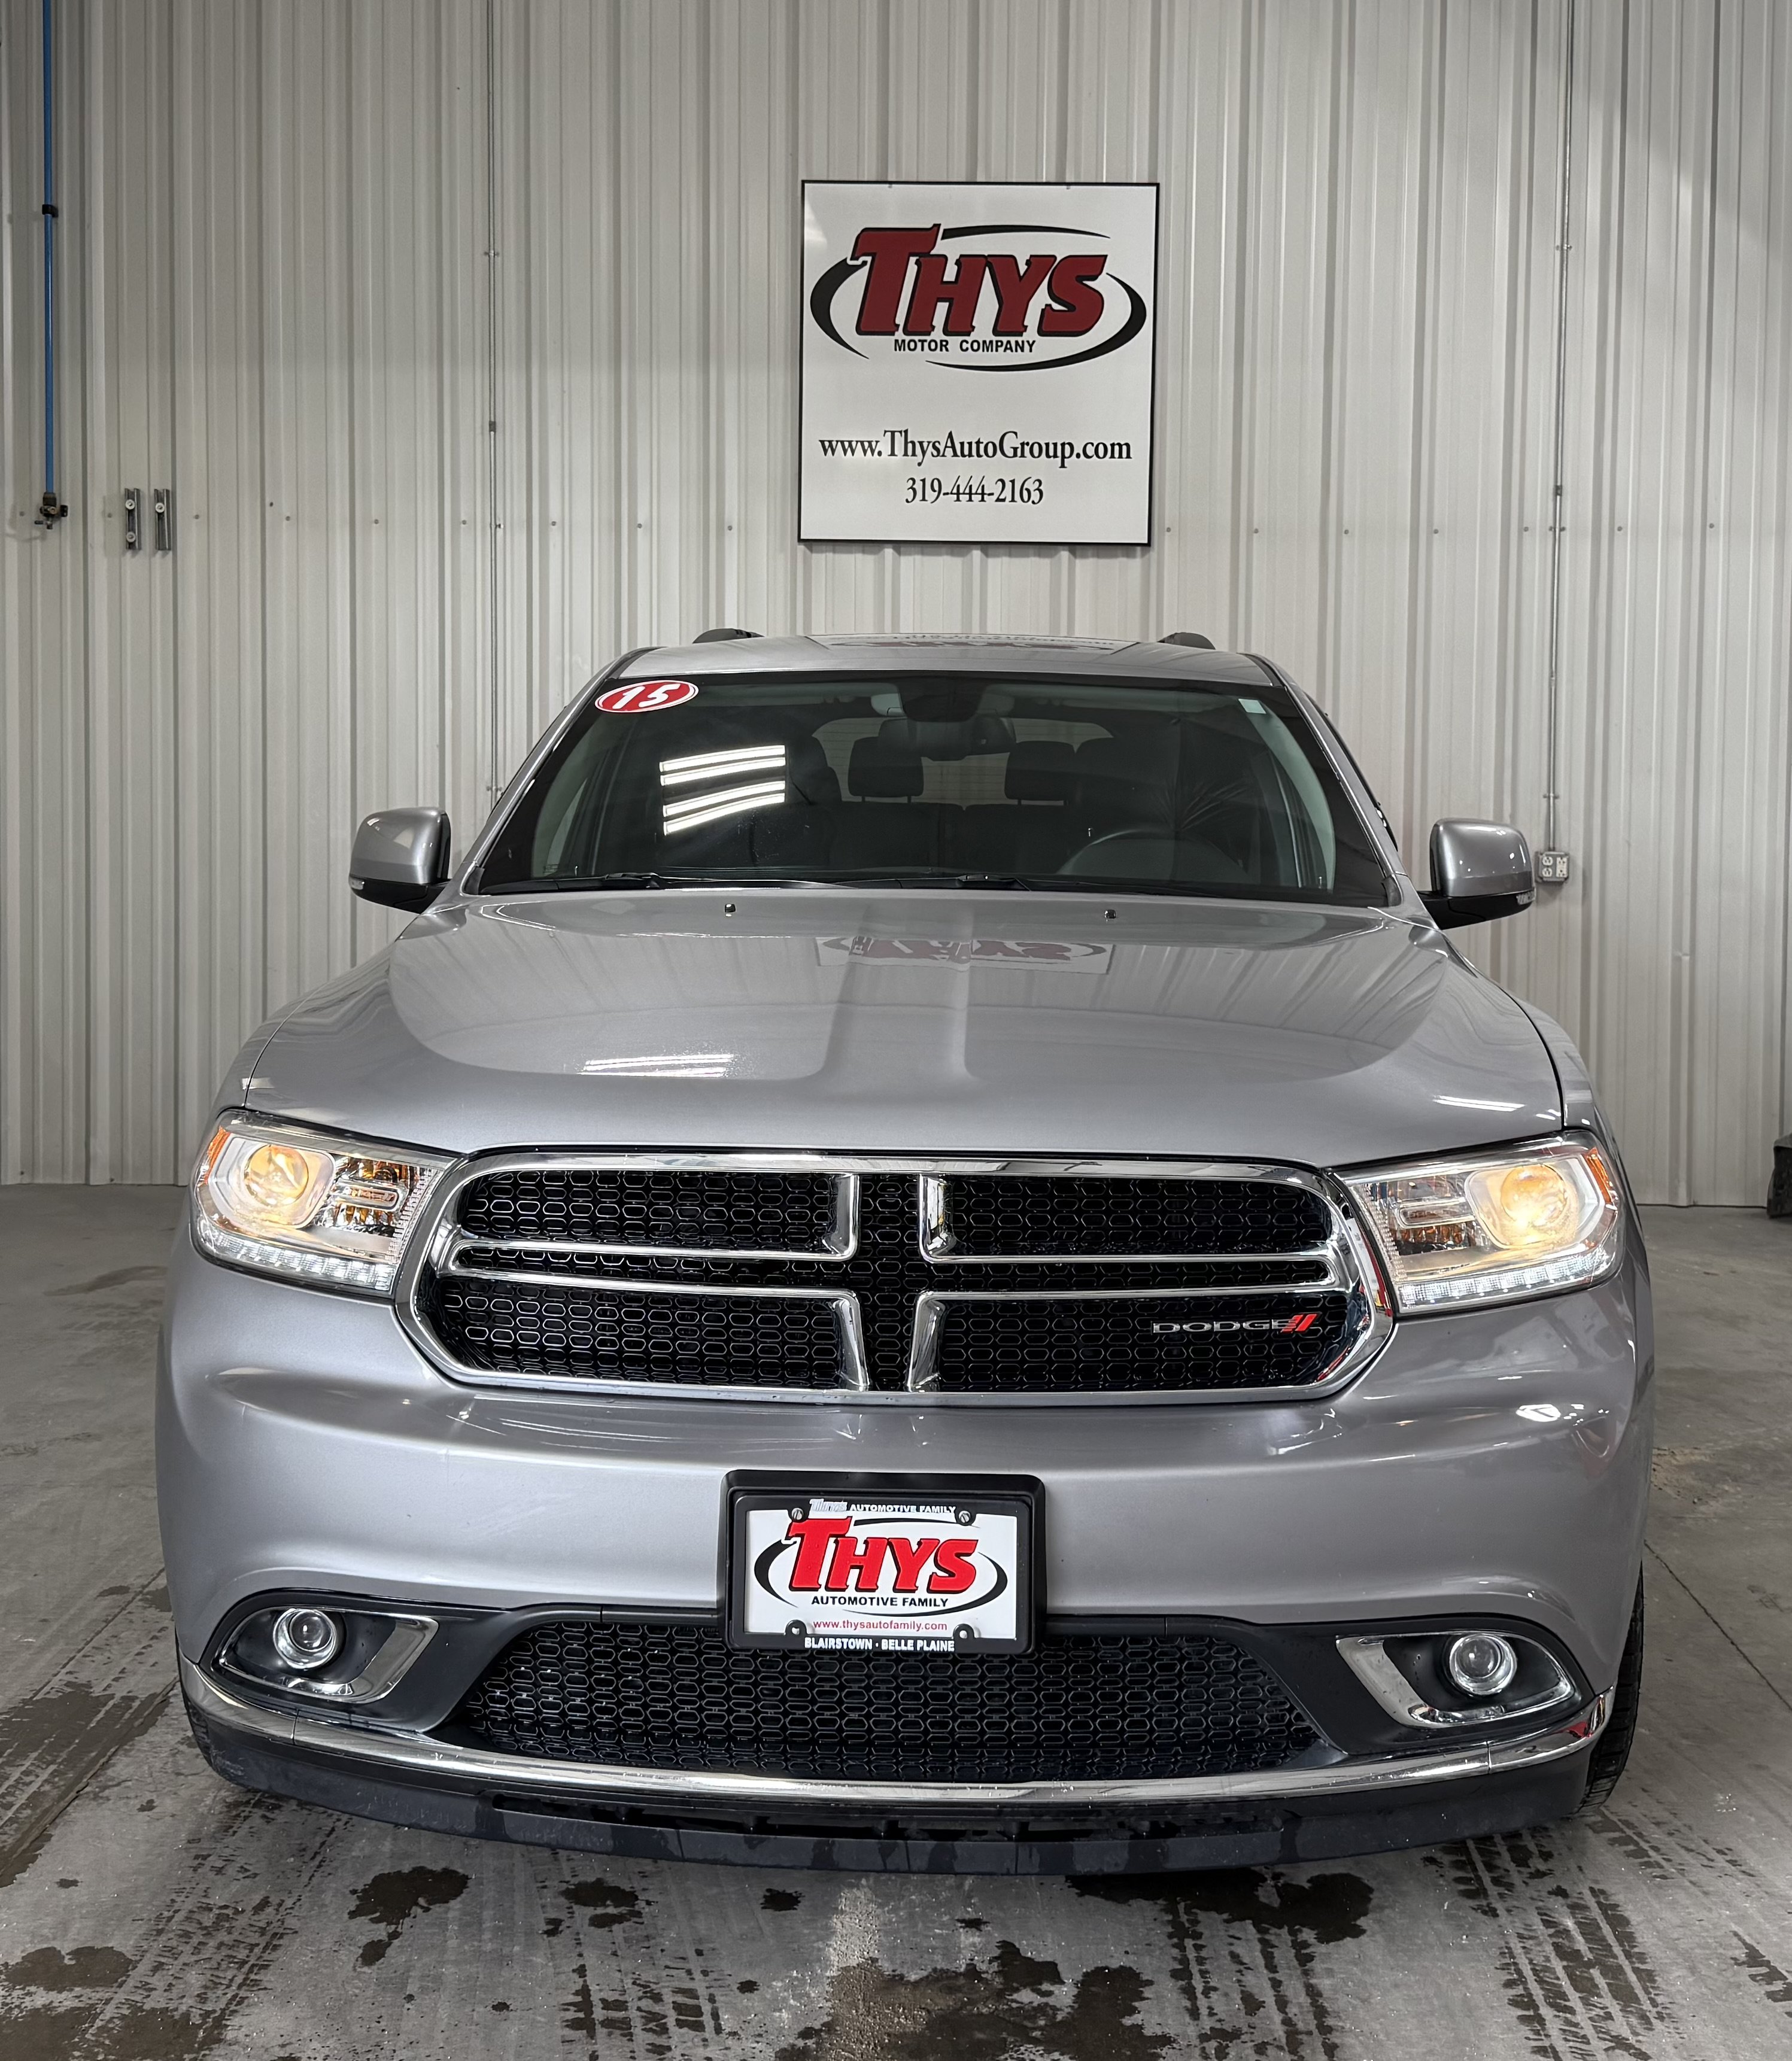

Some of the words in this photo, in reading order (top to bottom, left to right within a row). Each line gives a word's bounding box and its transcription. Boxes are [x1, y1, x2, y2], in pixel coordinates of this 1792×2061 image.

[851, 223, 1108, 338] THYS
[894, 339, 949, 352] MOTOR
[959, 339, 1036, 352] COMPANY
[818, 428, 1132, 469] www.ThysAutoGroup.com
[905, 475, 1044, 505] 319-444-2163
[612, 683, 681, 710] 15
[1153, 1319, 1296, 1333] DODGE
[850, 1504, 917, 1513] AUTOMOTIVE
[919, 1505, 956, 1513] FAMILY
[785, 1516, 979, 1594] THYS
[811, 1596, 898, 1606] AUTOMOTIVE
[902, 1598, 949, 1607] FAMILY
[813, 1619, 947, 1631] www.thysautofamily.com
[804, 1637, 873, 1650] BLAIRSTOWN
[881, 1639, 914, 1651] BELLE
[916, 1640, 955, 1652] PLAINE
